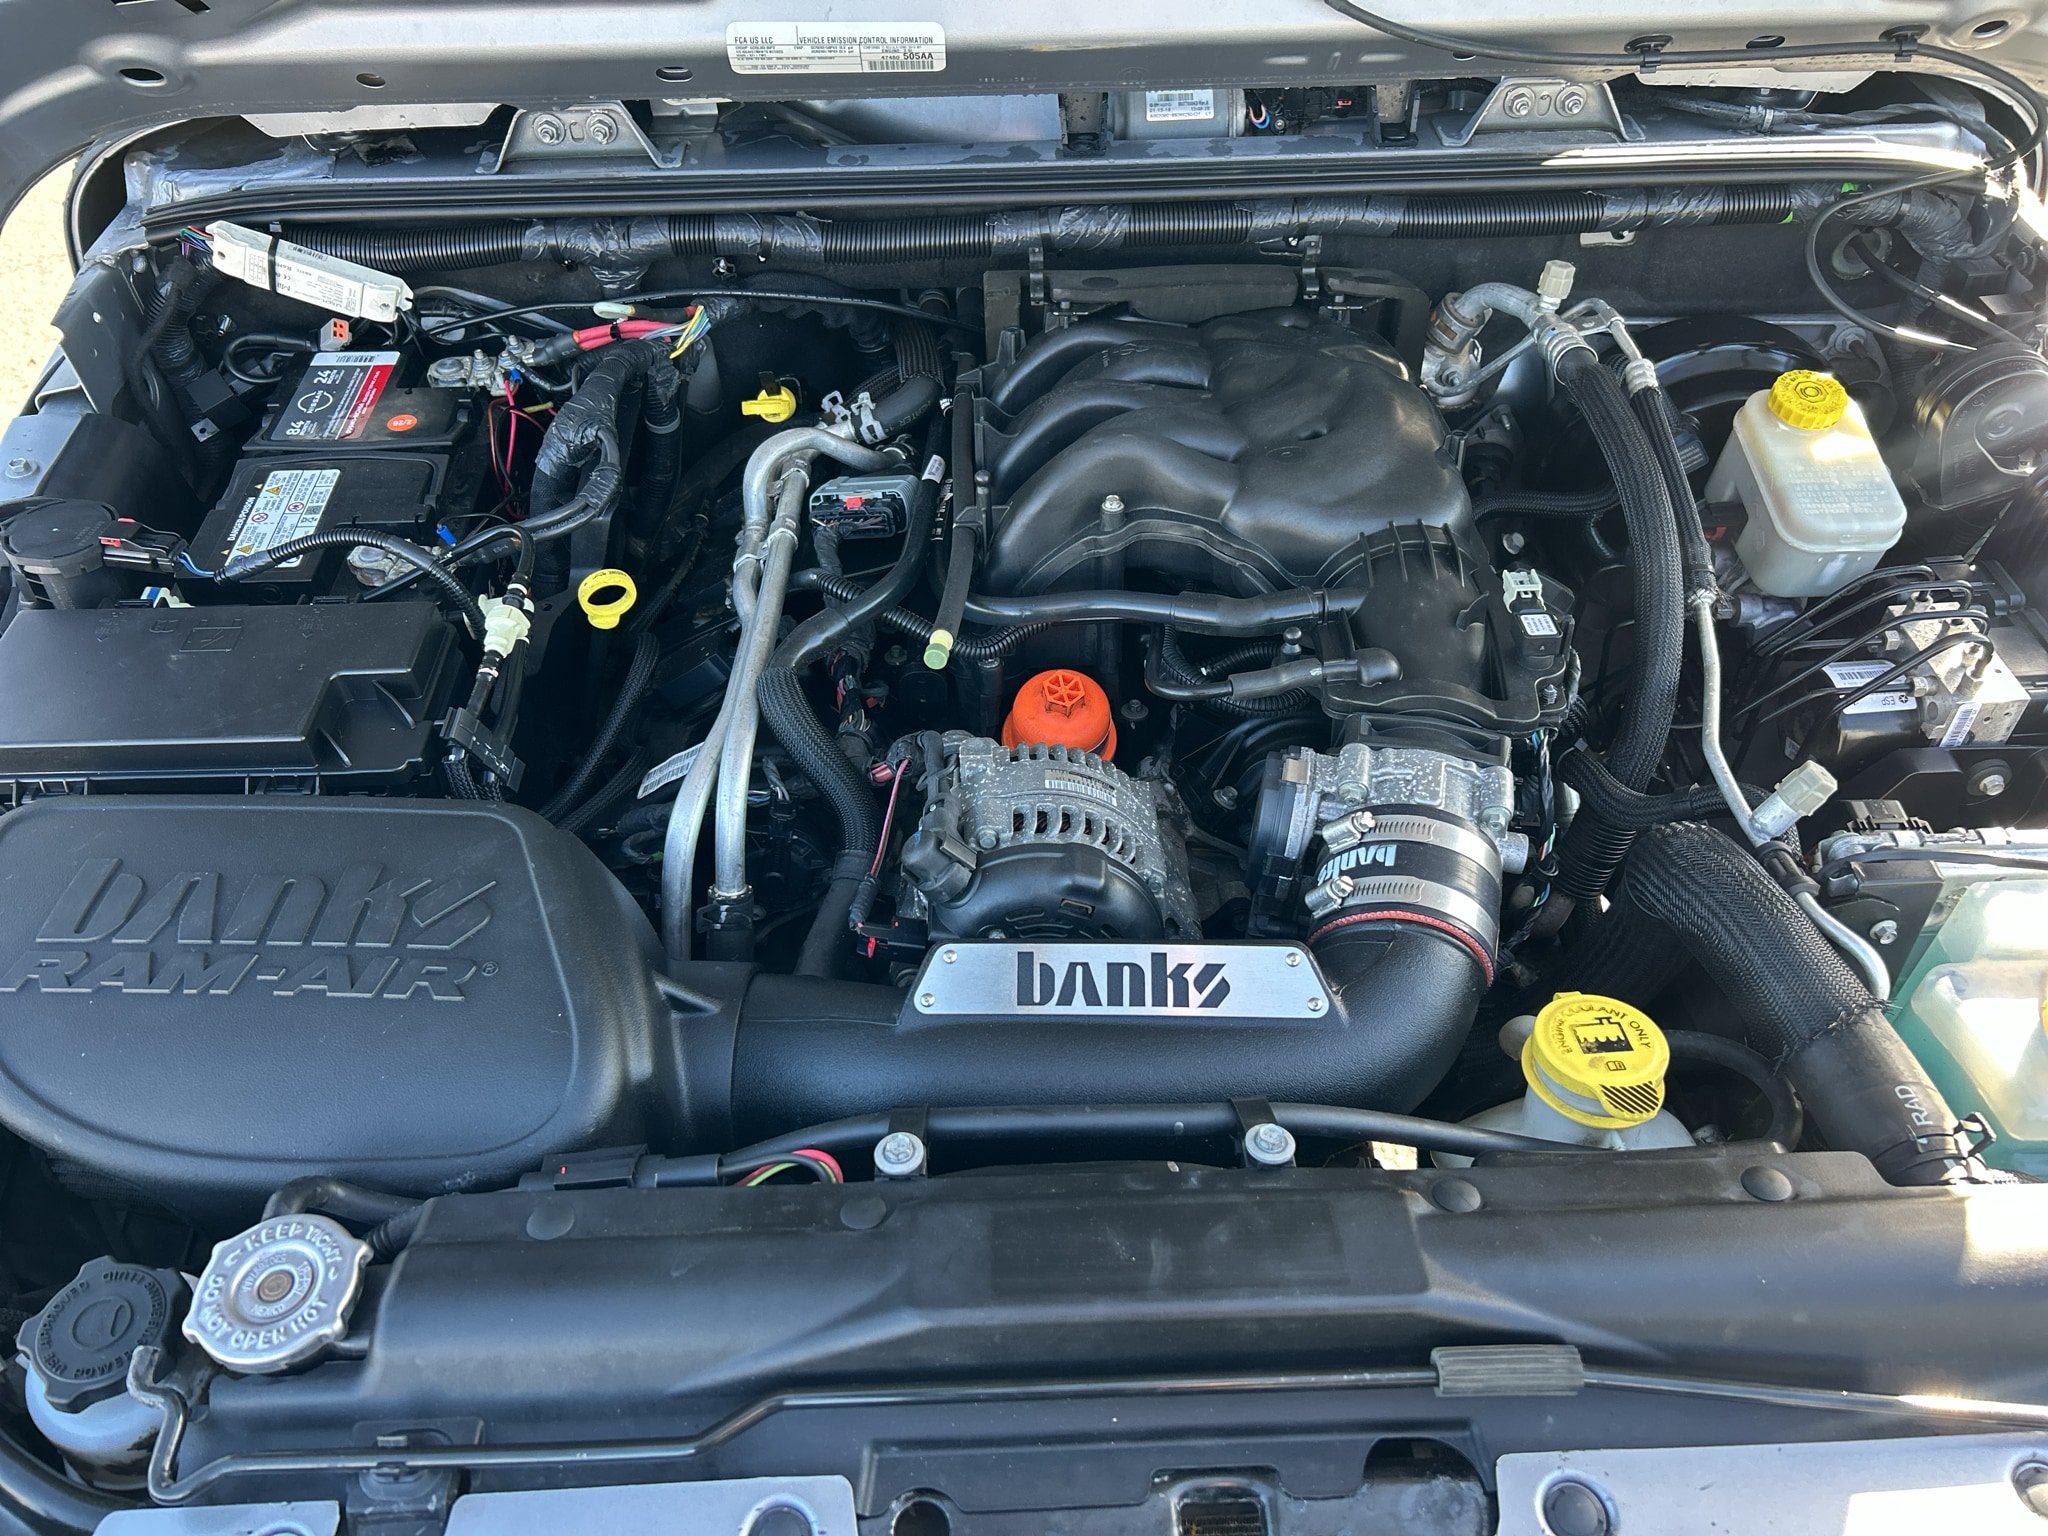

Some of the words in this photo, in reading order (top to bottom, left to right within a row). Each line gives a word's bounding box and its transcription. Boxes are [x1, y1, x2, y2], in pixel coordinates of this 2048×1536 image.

[859, 36, 887, 44] CONTROL
[313, 368, 331, 383] 24
[306, 390, 322, 413] NISSAN
[286, 420, 304, 435] 84
[1881, 695, 1896, 706] ESP
[35, 858, 497, 951] banks
[1016, 951, 1231, 1009] banks
[1629, 1020, 1652, 1049] ONLY
[1894, 1085, 1934, 1126] RAD
[243, 1222, 304, 1252] KEEP
[231, 1326, 289, 1350] OPEN
[290, 1298, 329, 1334] HOT
[43, 1351, 68, 1376] USE
